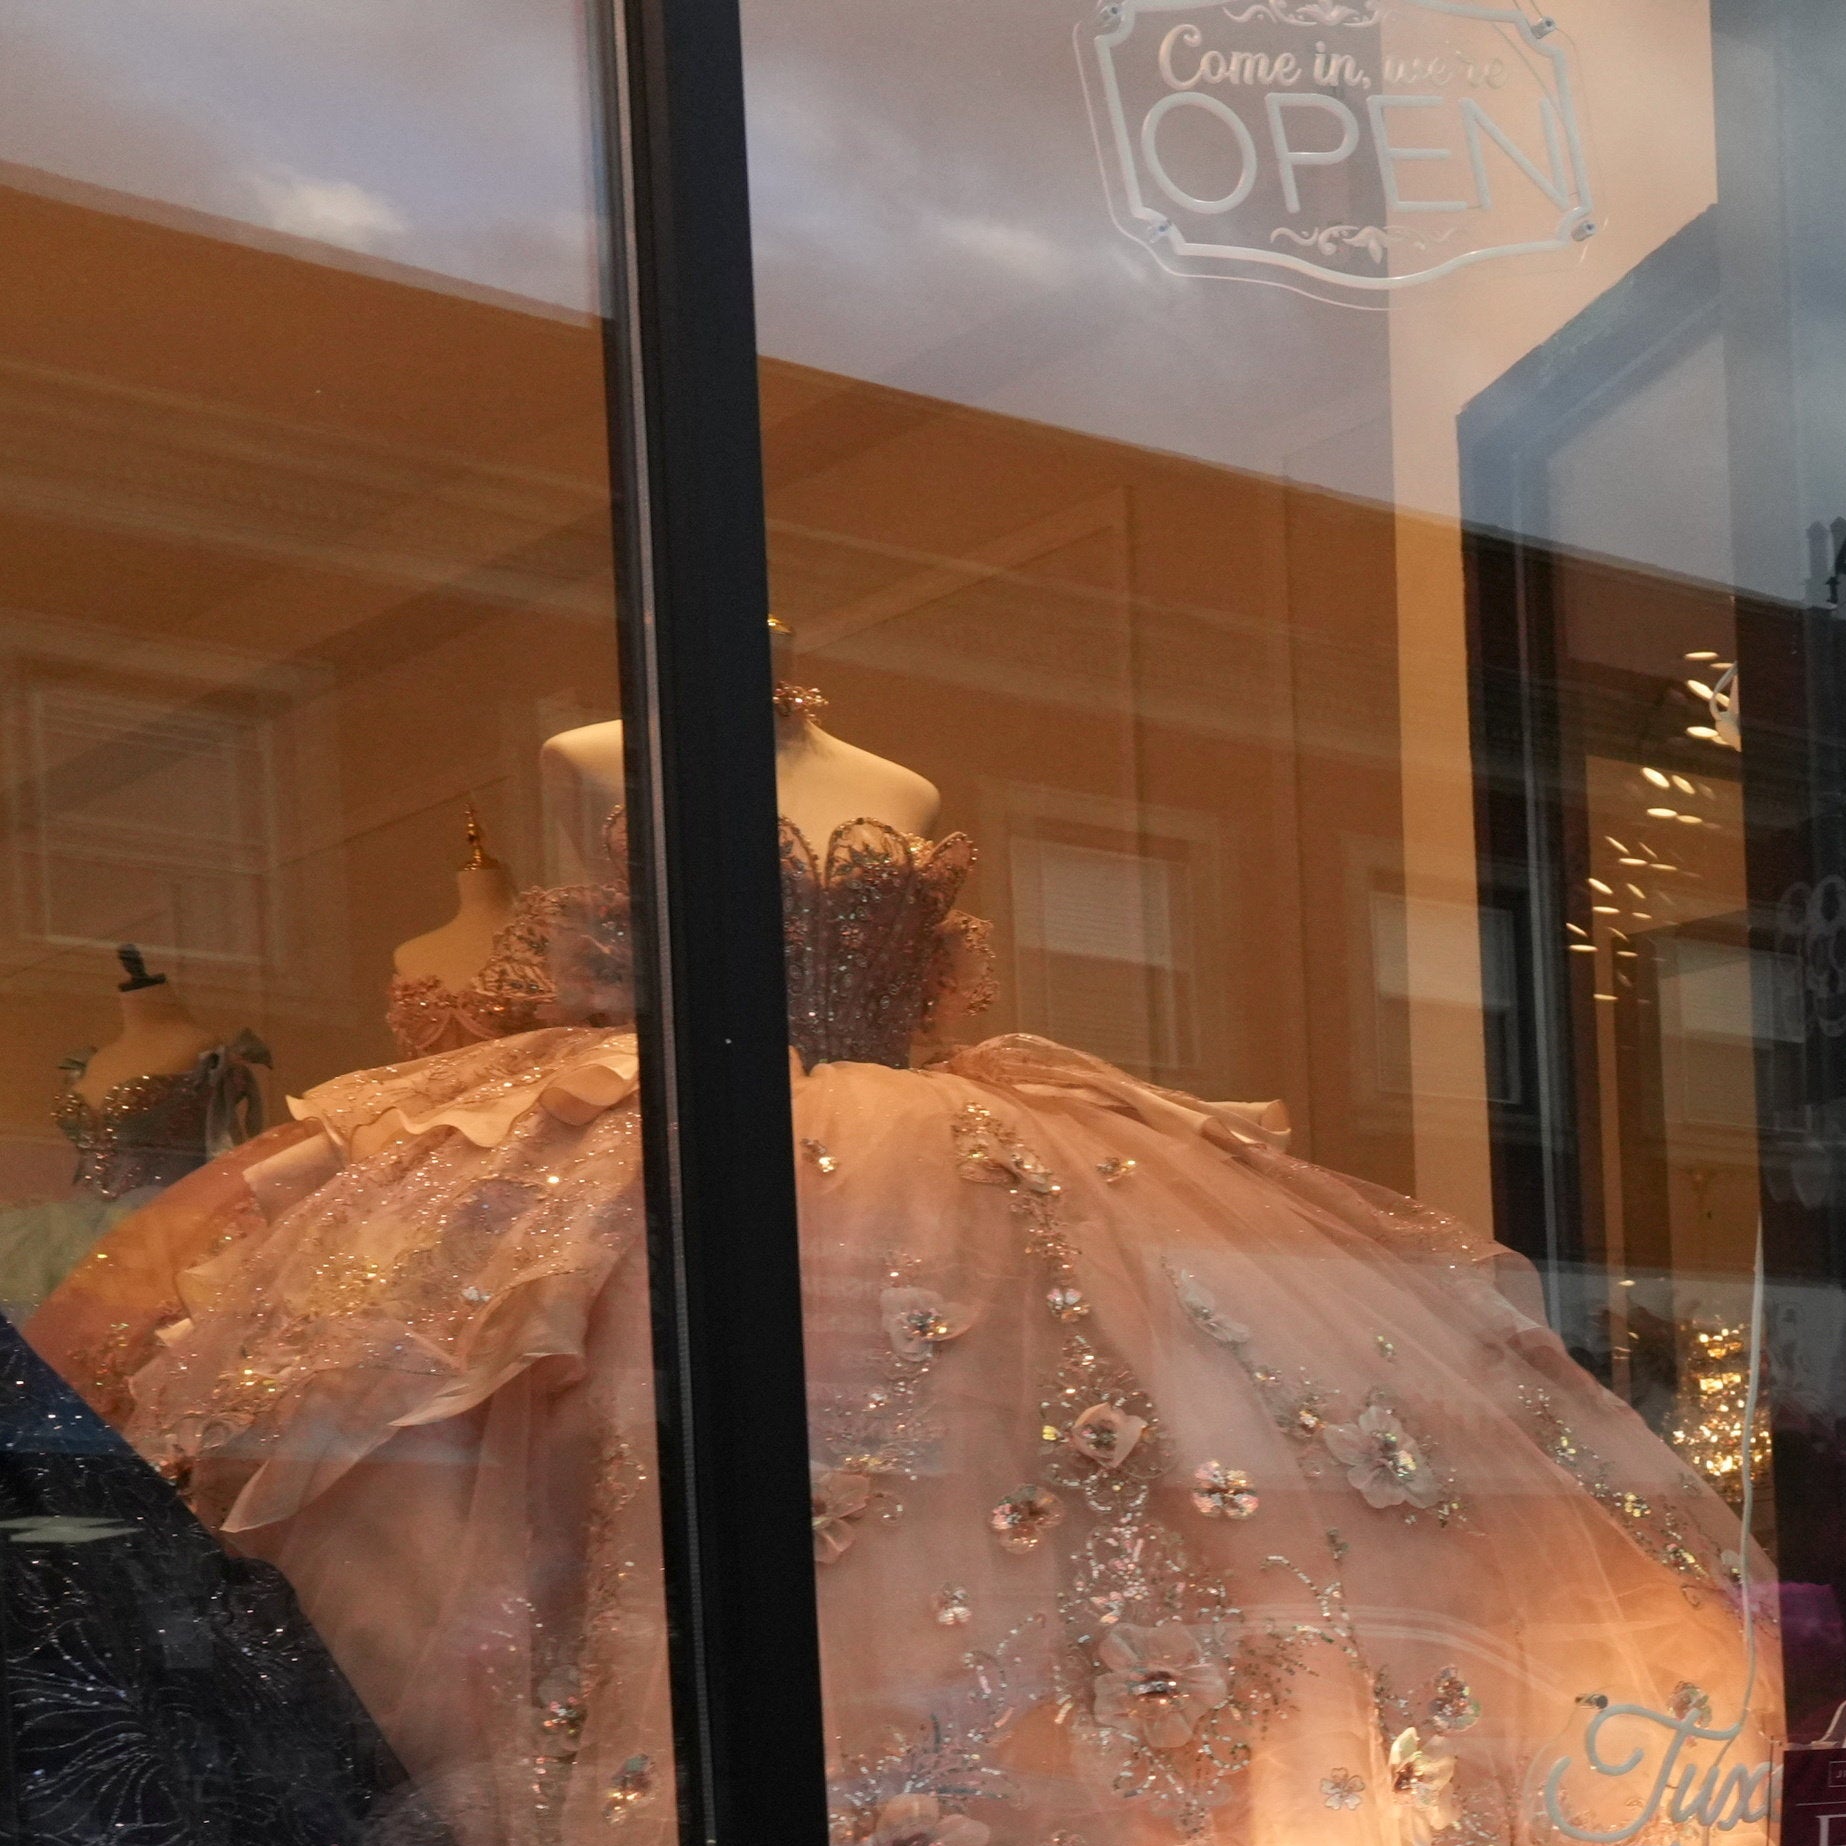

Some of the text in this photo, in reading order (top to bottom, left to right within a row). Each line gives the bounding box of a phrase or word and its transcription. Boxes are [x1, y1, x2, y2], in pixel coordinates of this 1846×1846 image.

[1158, 23, 1302, 90] Come
[1311, 40, 1372, 90] in,
[1141, 91, 1574, 214] OPEN
